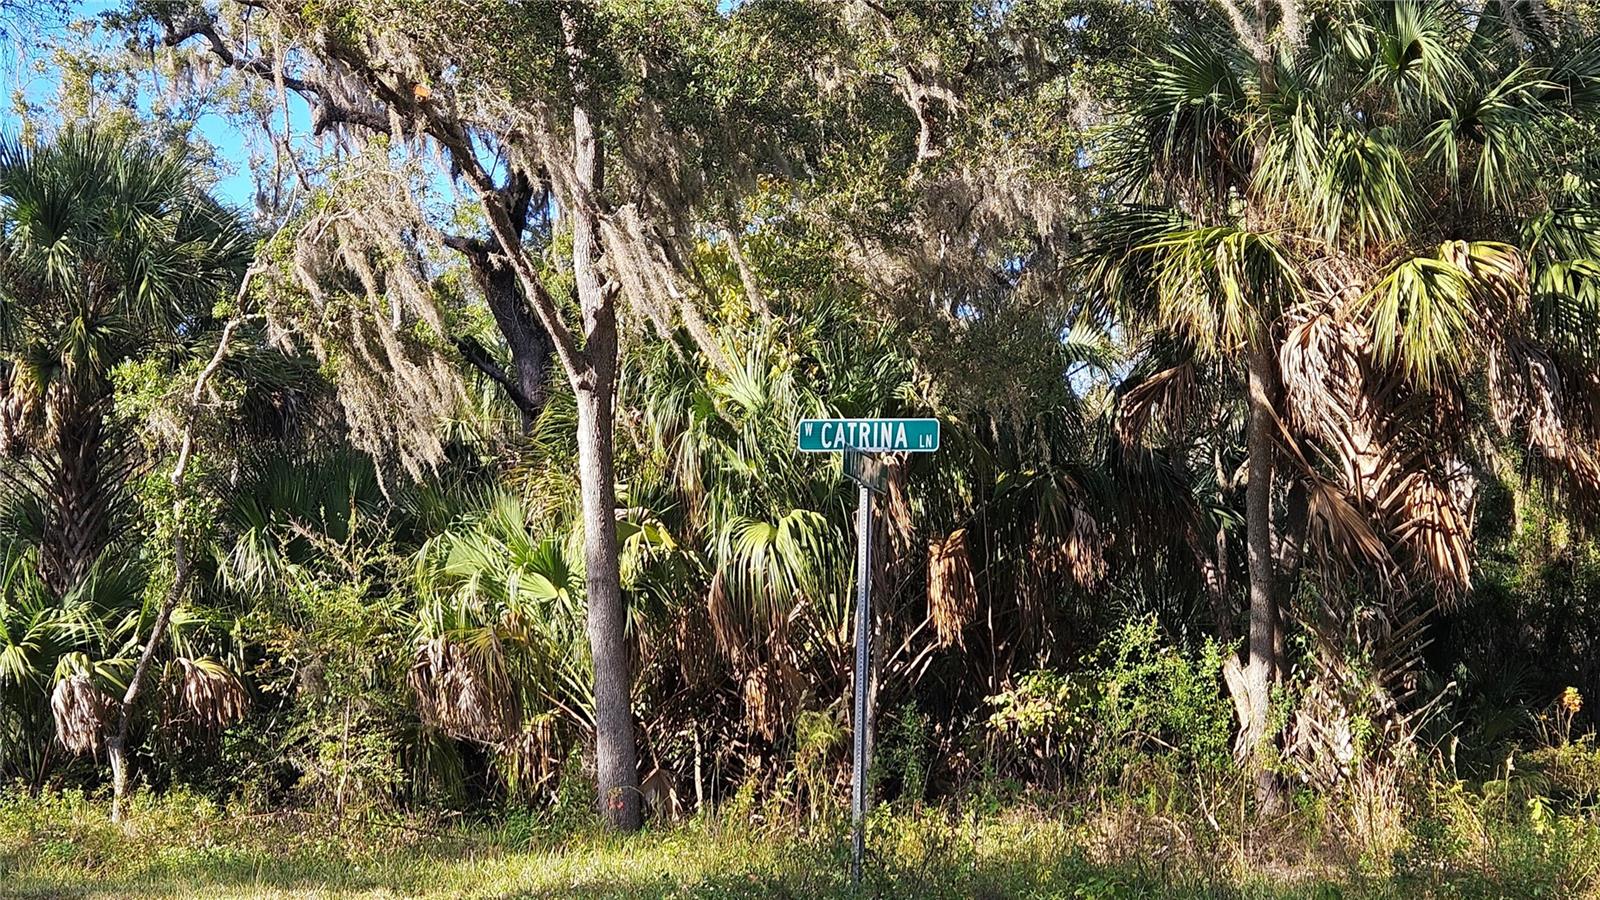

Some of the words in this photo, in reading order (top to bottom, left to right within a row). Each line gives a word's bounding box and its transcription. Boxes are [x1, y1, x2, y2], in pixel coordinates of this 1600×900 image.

[805, 422, 813, 436] W
[821, 422, 908, 448] CATRINA
[919, 434, 932, 448] LN
